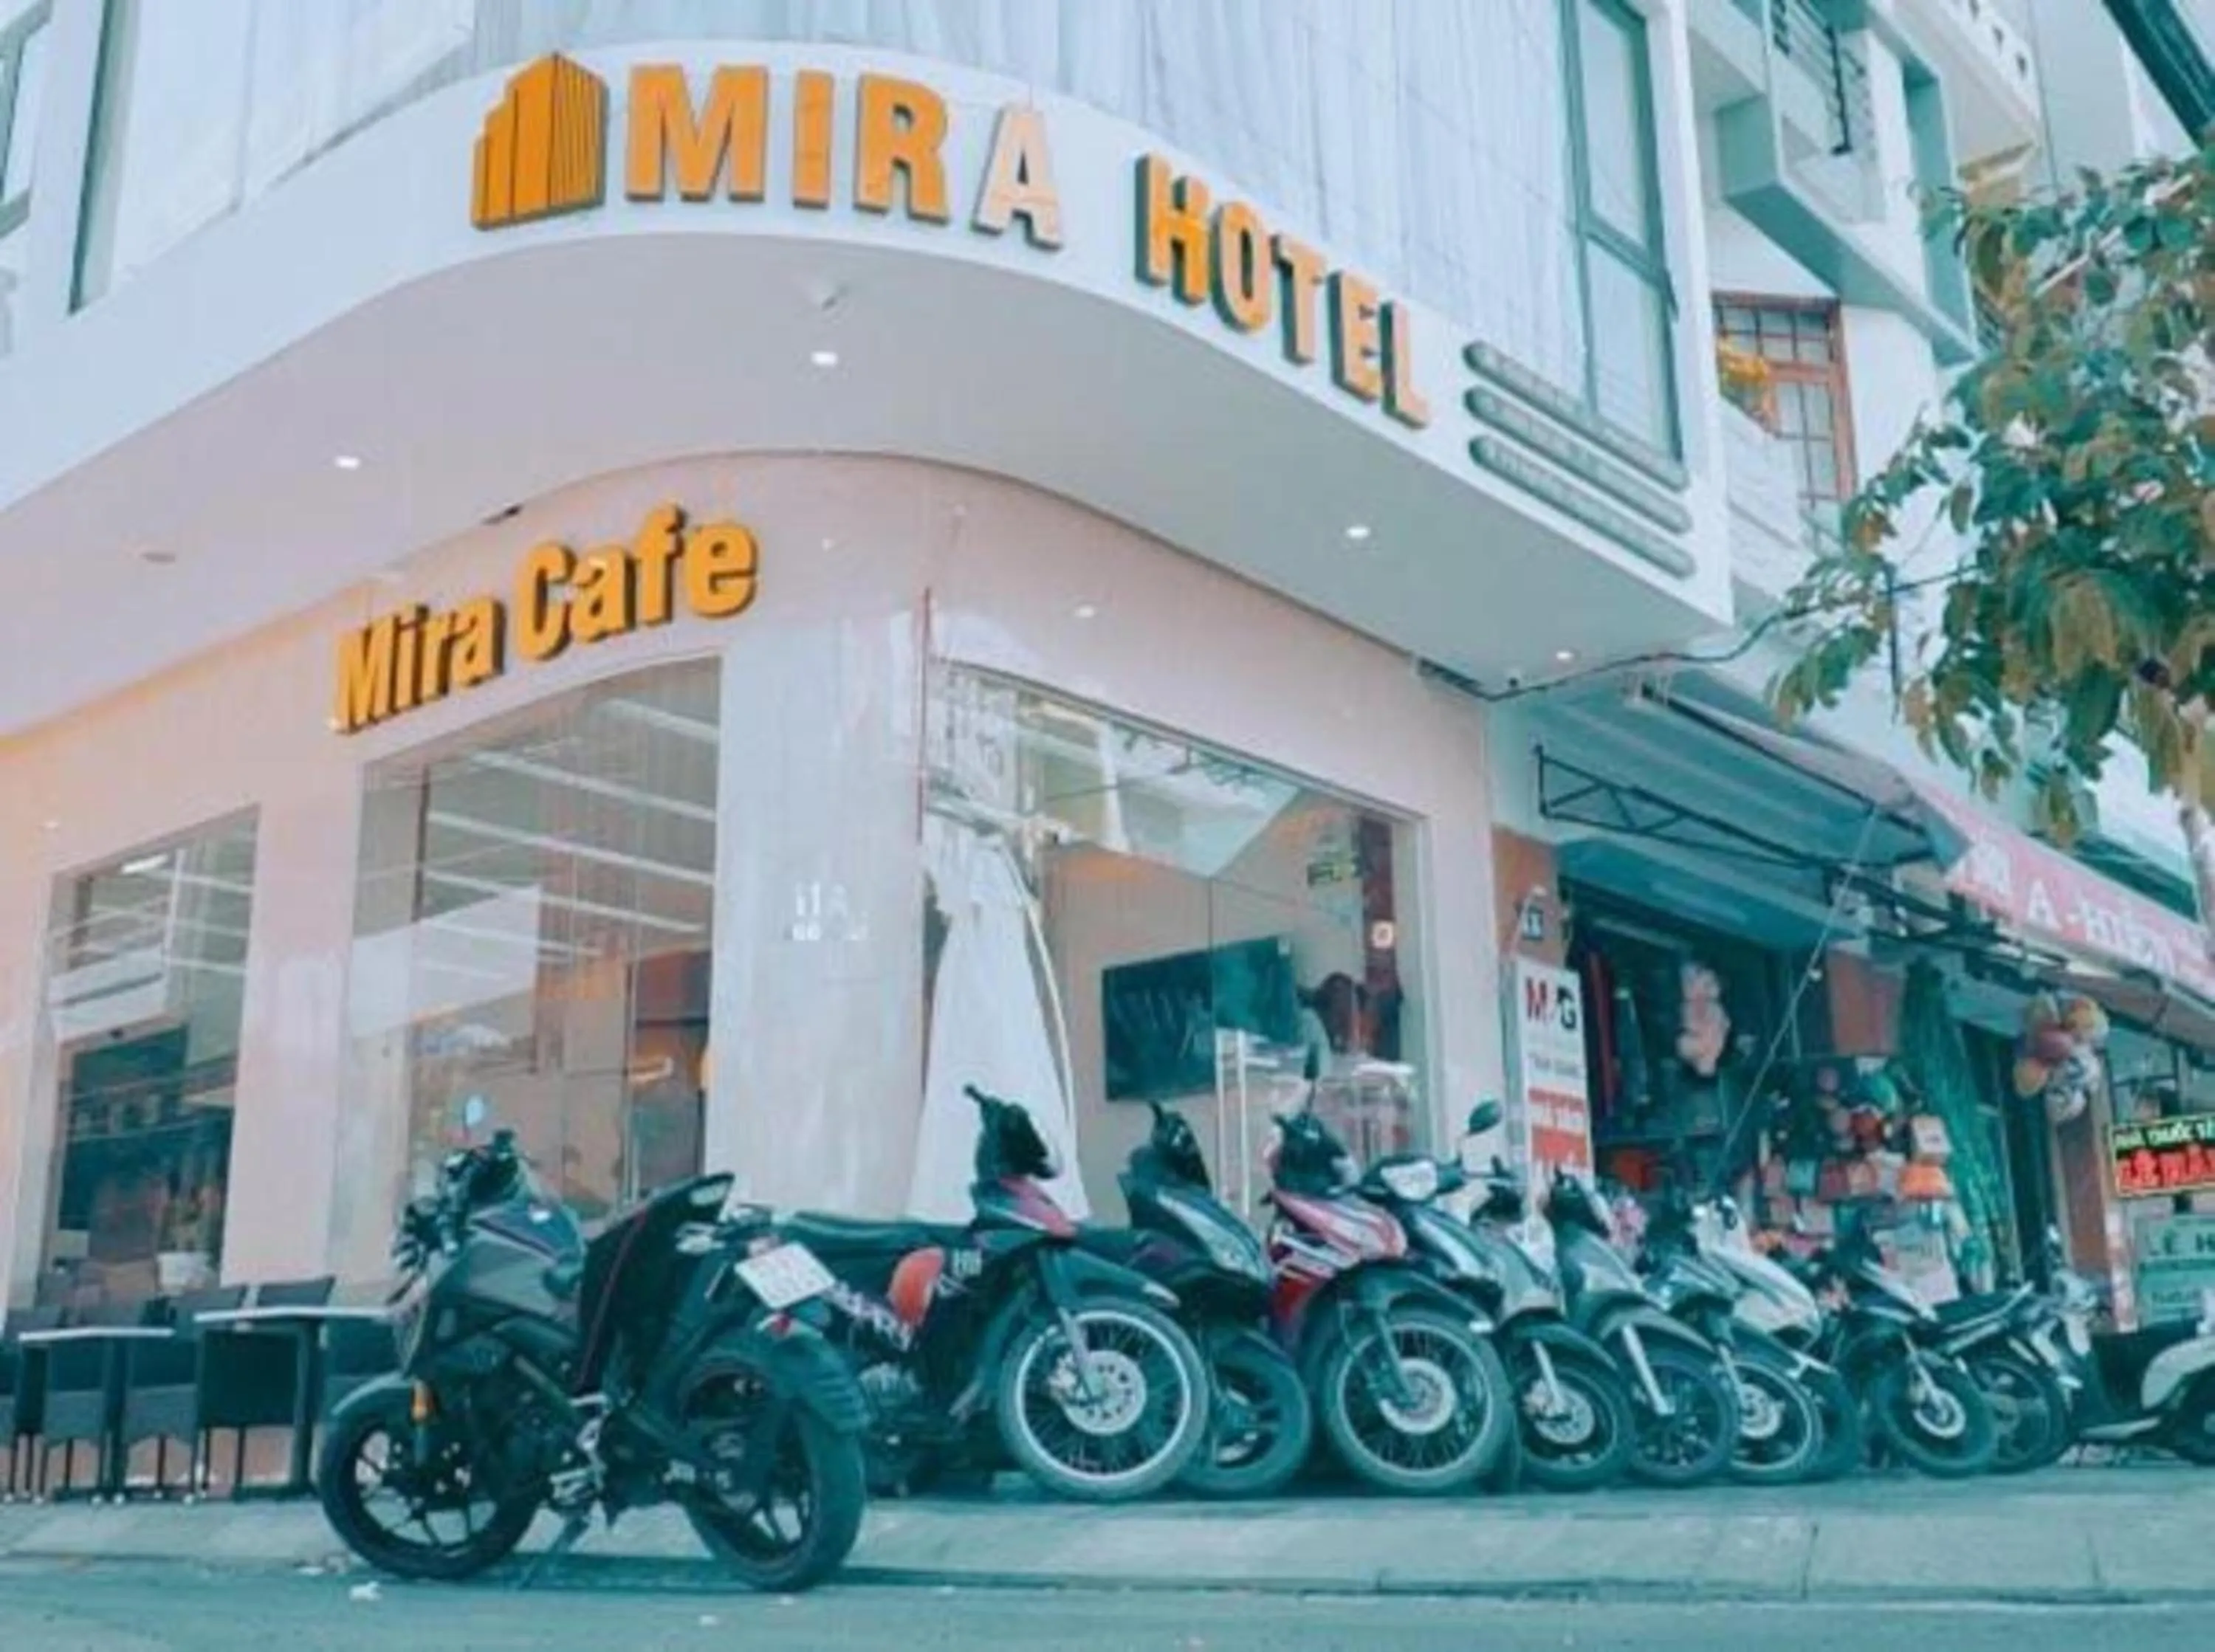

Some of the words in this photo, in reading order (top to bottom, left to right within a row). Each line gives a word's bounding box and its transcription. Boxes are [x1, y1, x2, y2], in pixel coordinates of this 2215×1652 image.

[625, 63, 1063, 250] MIRA
[1136, 151, 1431, 430] HOTEL
[332, 597, 505, 734] Mira
[516, 498, 758, 661] Cafe
